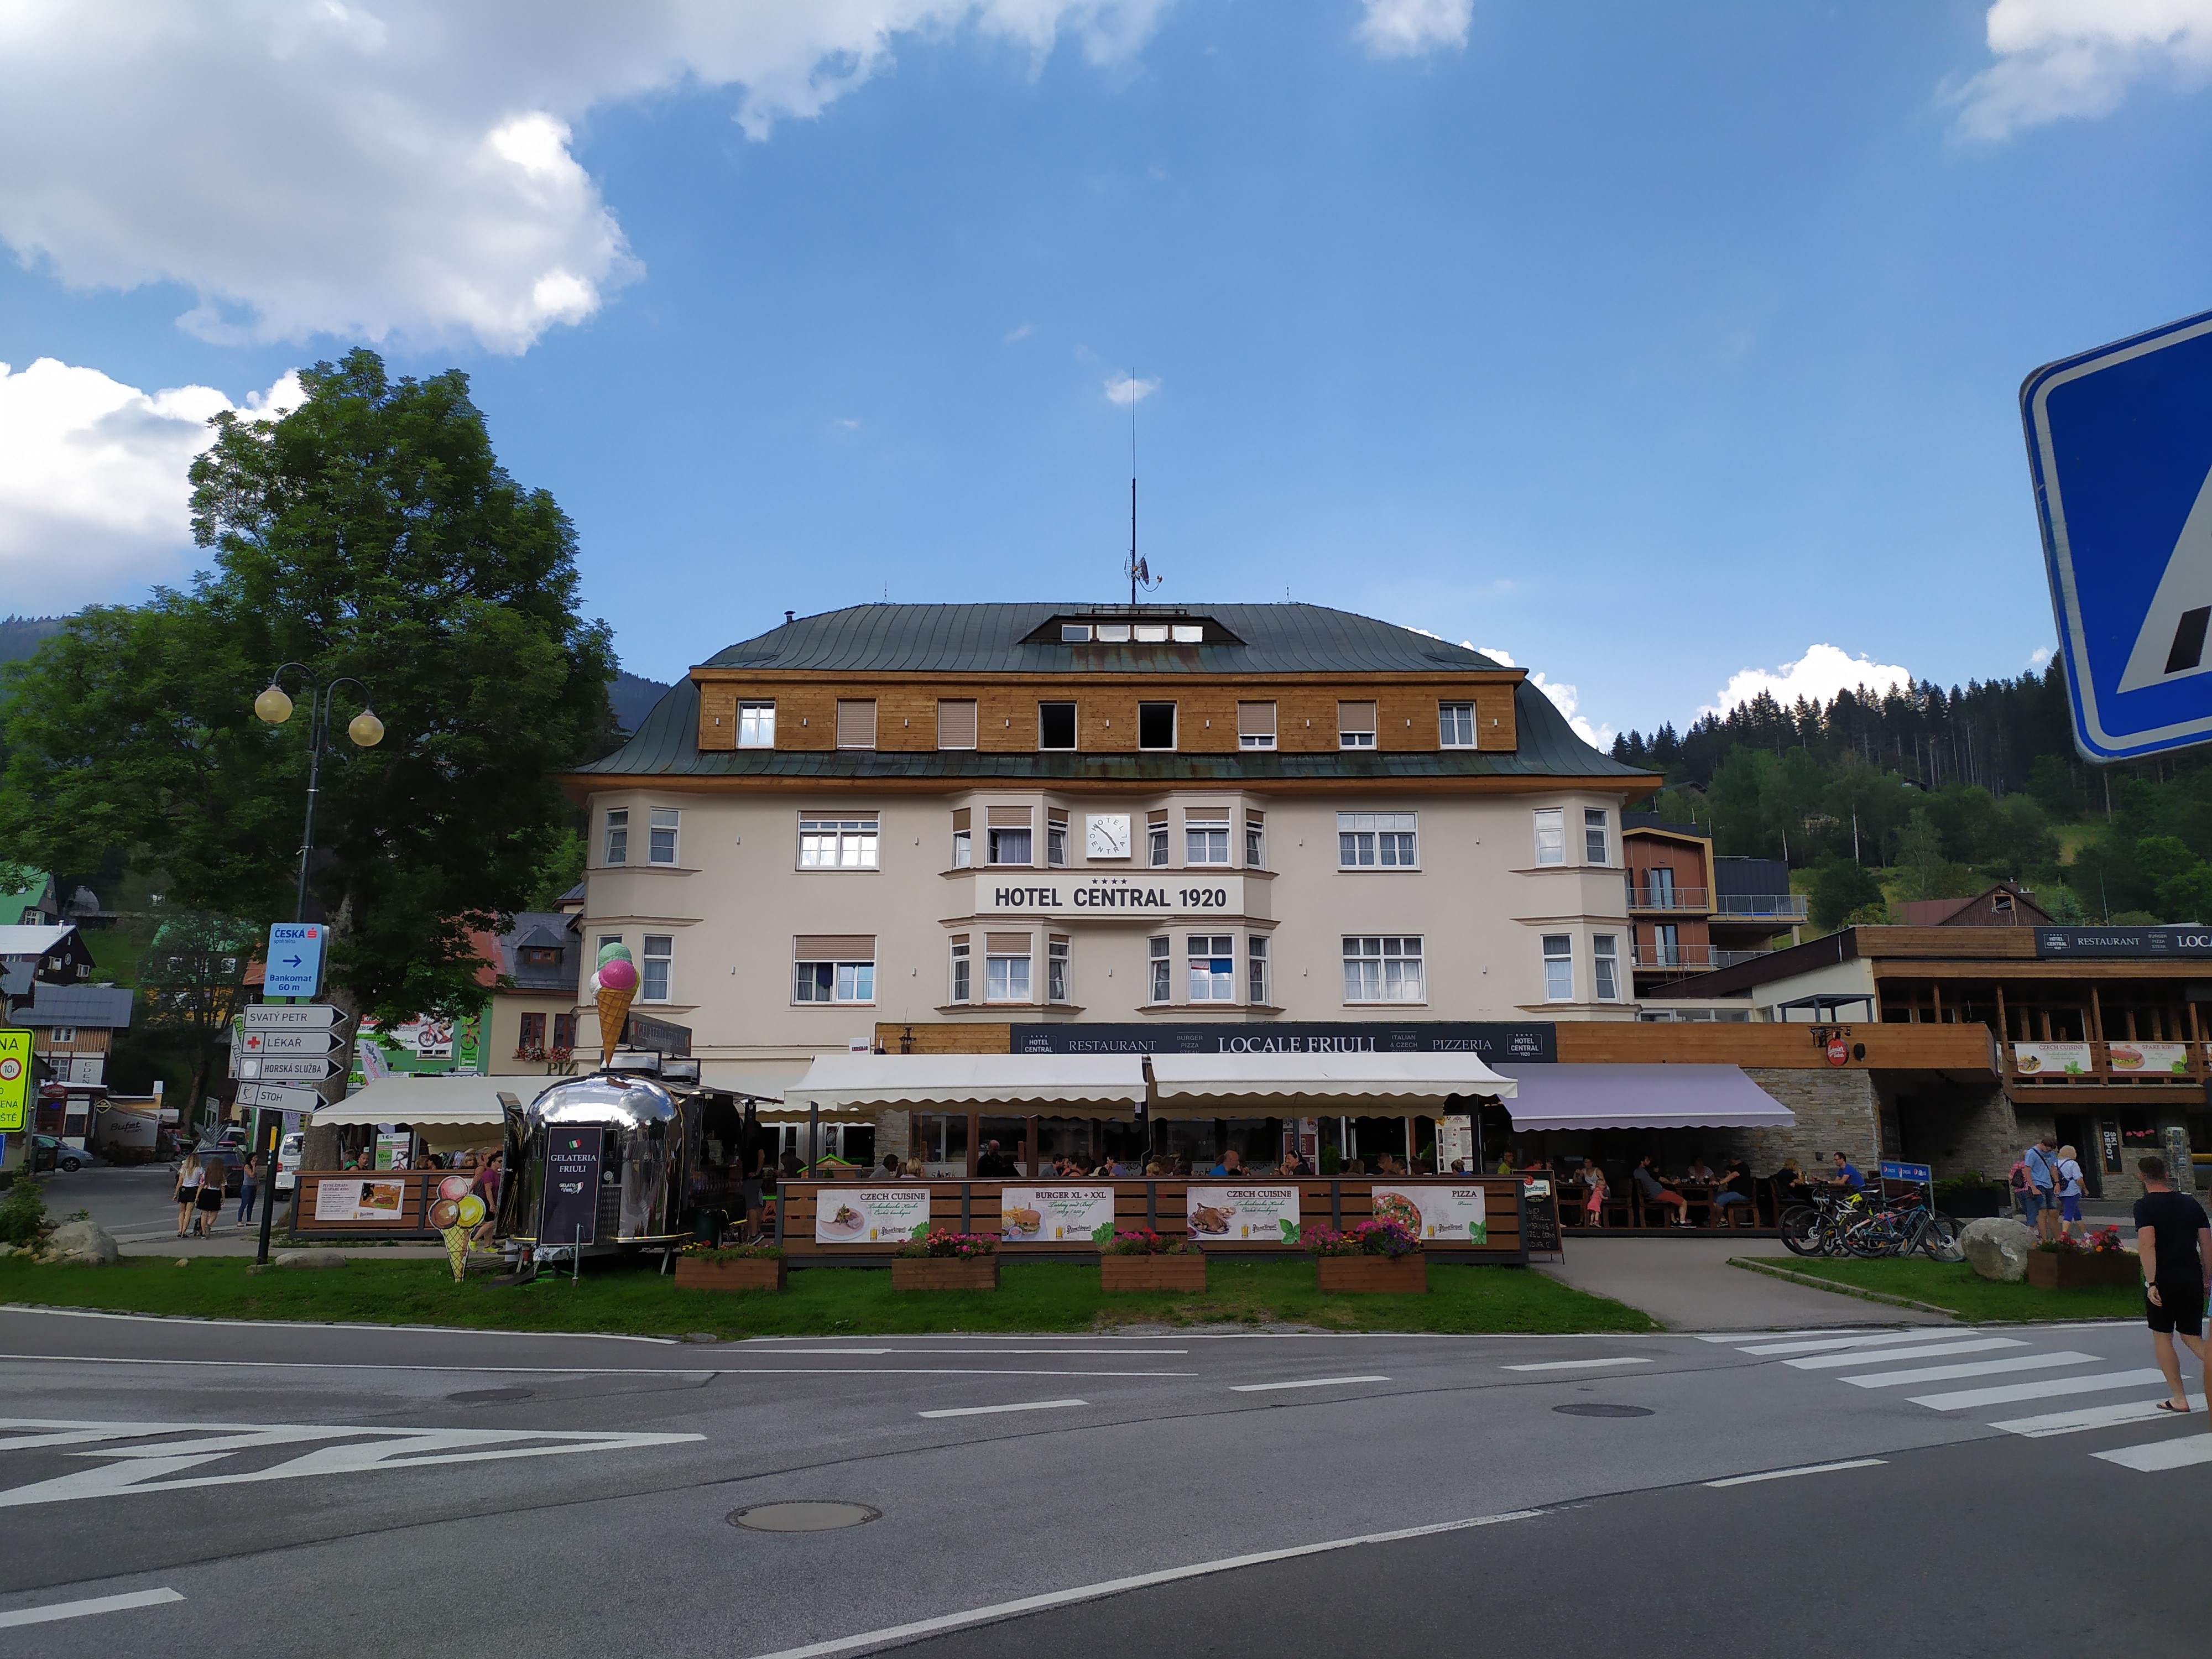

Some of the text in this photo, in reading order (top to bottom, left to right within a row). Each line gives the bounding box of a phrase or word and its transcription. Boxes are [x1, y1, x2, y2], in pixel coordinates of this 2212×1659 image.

[995, 888, 1227, 907] HOTEL CENTRAL 1920
[275, 927, 305, 938] ČESKÁ
[2078, 937, 2140, 946] RESTAURANT
[250, 1011, 307, 1021] SVATÝ PETR
[268, 1037, 301, 1047] LÉKAŘ
[1068, 1040, 1156, 1051] RESTAURANT
[1218, 1037, 1376, 1053] LOCALE FRIULI
[1432, 1040, 1493, 1050] PIZZERIA
[264, 1063, 321, 1073] HORSKÁ SLUŽBA
[260, 1092, 283, 1102] STOH
[111, 1121, 141, 1132] Bufet
[2104, 1131, 2114, 1160] DEPOT
